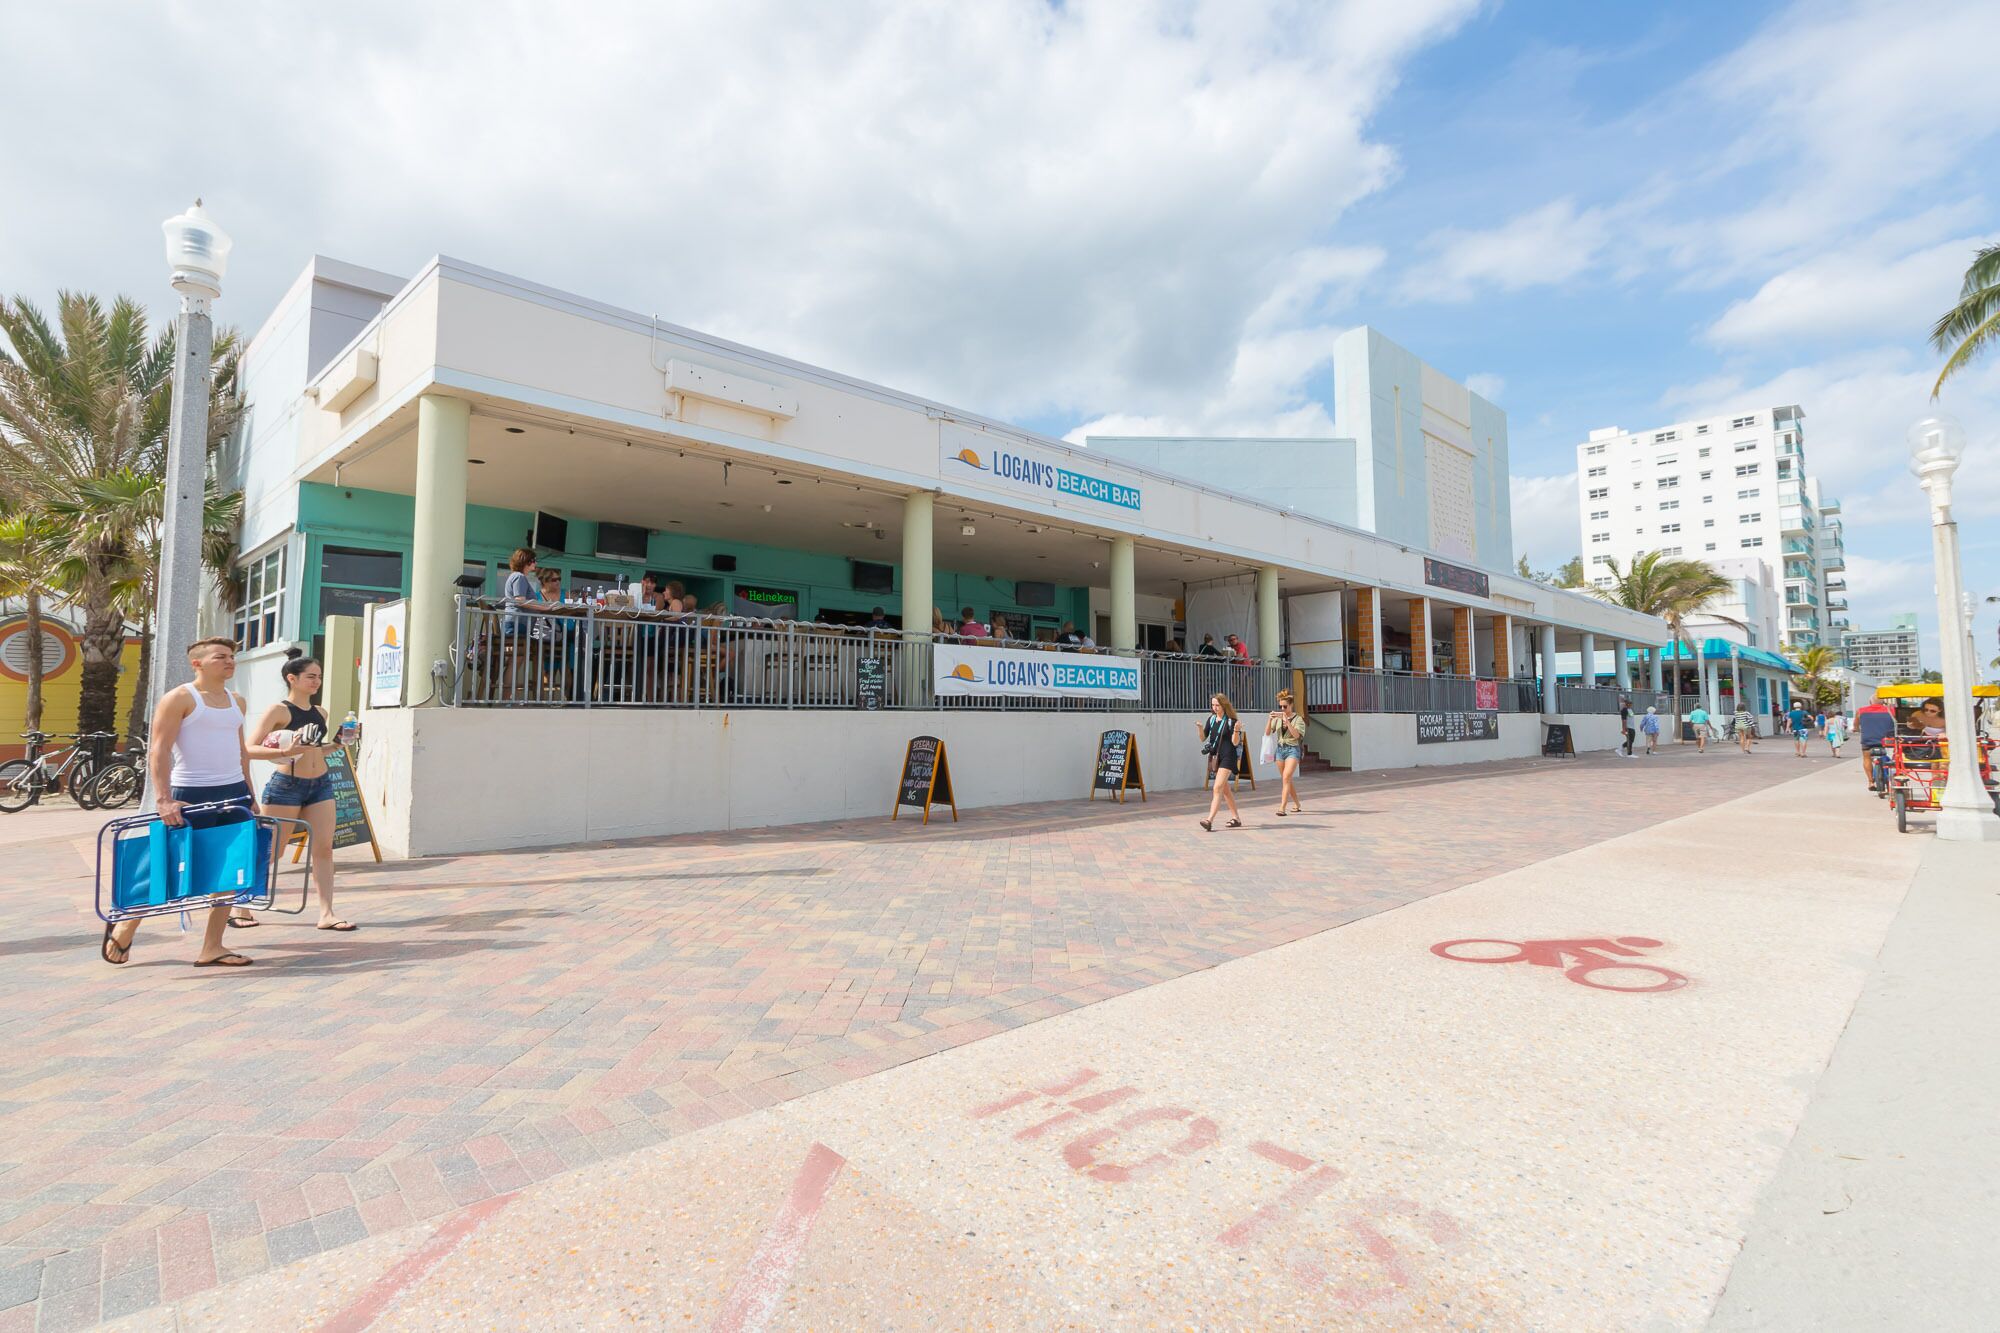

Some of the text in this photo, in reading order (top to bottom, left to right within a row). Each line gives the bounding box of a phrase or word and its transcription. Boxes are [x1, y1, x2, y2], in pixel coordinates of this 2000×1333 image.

[993, 451, 1140, 508] LOGAN'S BEACH BAR
[749, 590, 795, 603] Heineken
[988, 660, 1137, 688] LOGAN'S BEACH BAR
[1420, 714, 1443, 726] HOOKAH
[1420, 726, 1445, 738] FLAVORS
[910, 762, 922, 777] HOT
[907, 790, 917, 800] $6
[969, 1067, 1467, 1308] SLOW
